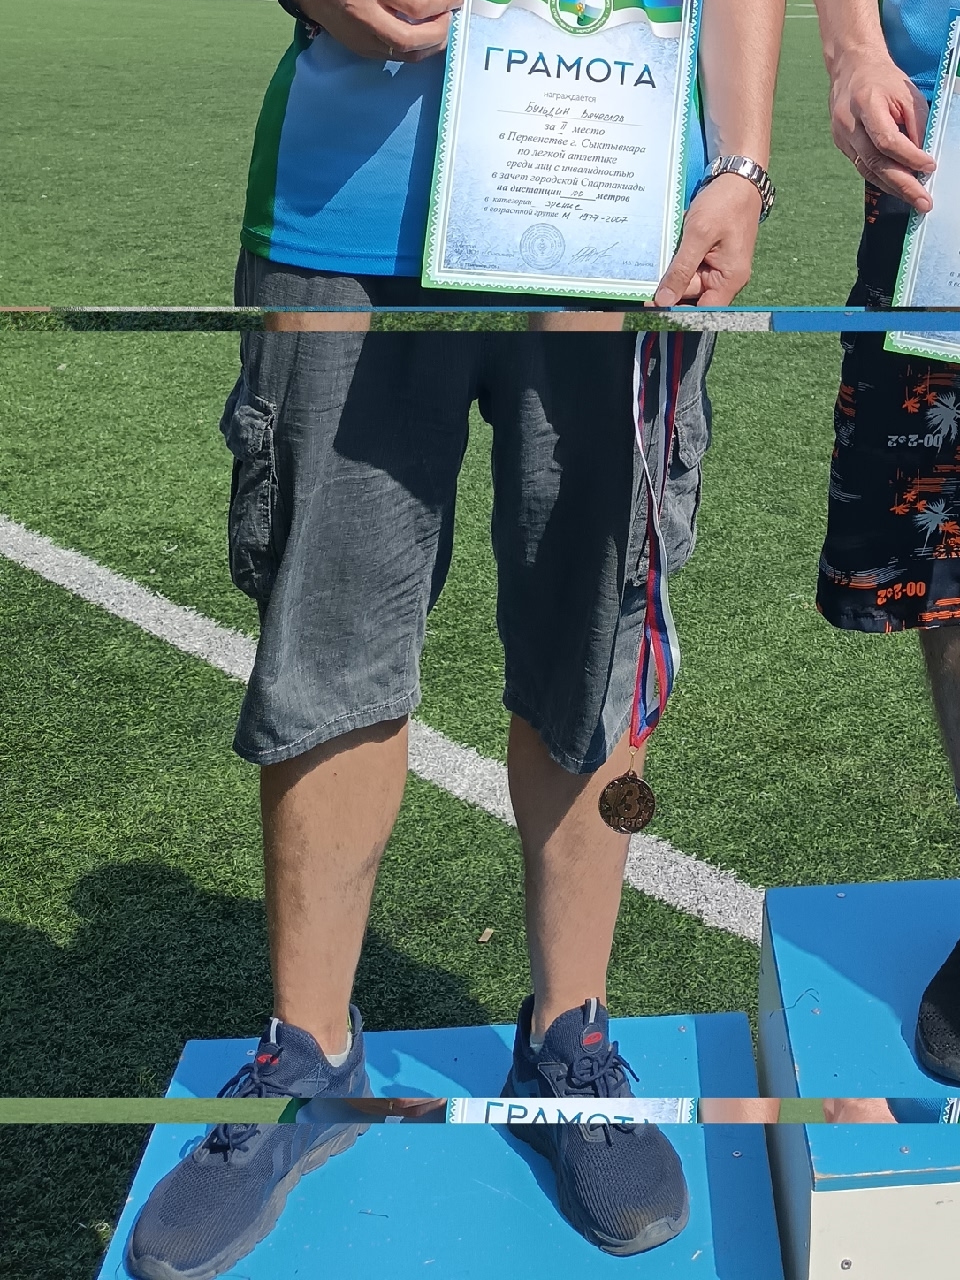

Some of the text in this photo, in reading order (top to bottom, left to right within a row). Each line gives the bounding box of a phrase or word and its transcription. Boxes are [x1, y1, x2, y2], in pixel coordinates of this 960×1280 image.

[484, 46, 656, 89] ГРАМОТА
[543, 91, 597, 104] награждается
[572, 125, 606, 136] место
[507, 130, 568, 147] Первенстве
[570, 139, 577, 147] г.
[581, 138, 646, 155] Сыктывкара
[517, 148, 530, 156] по
[567, 153, 618, 165] атлетике
[506, 160, 533, 170] среди
[534, 163, 551, 173] лиц
[561, 166, 635, 179] инвалидностью
[499, 172, 529, 181] зачет
[530, 174, 578, 187] городской
[581, 178, 645, 192] Спартакиады
[497, 184, 508, 192] на
[510, 185, 561, 196] дистанции
[596, 193, 630, 203] метров
